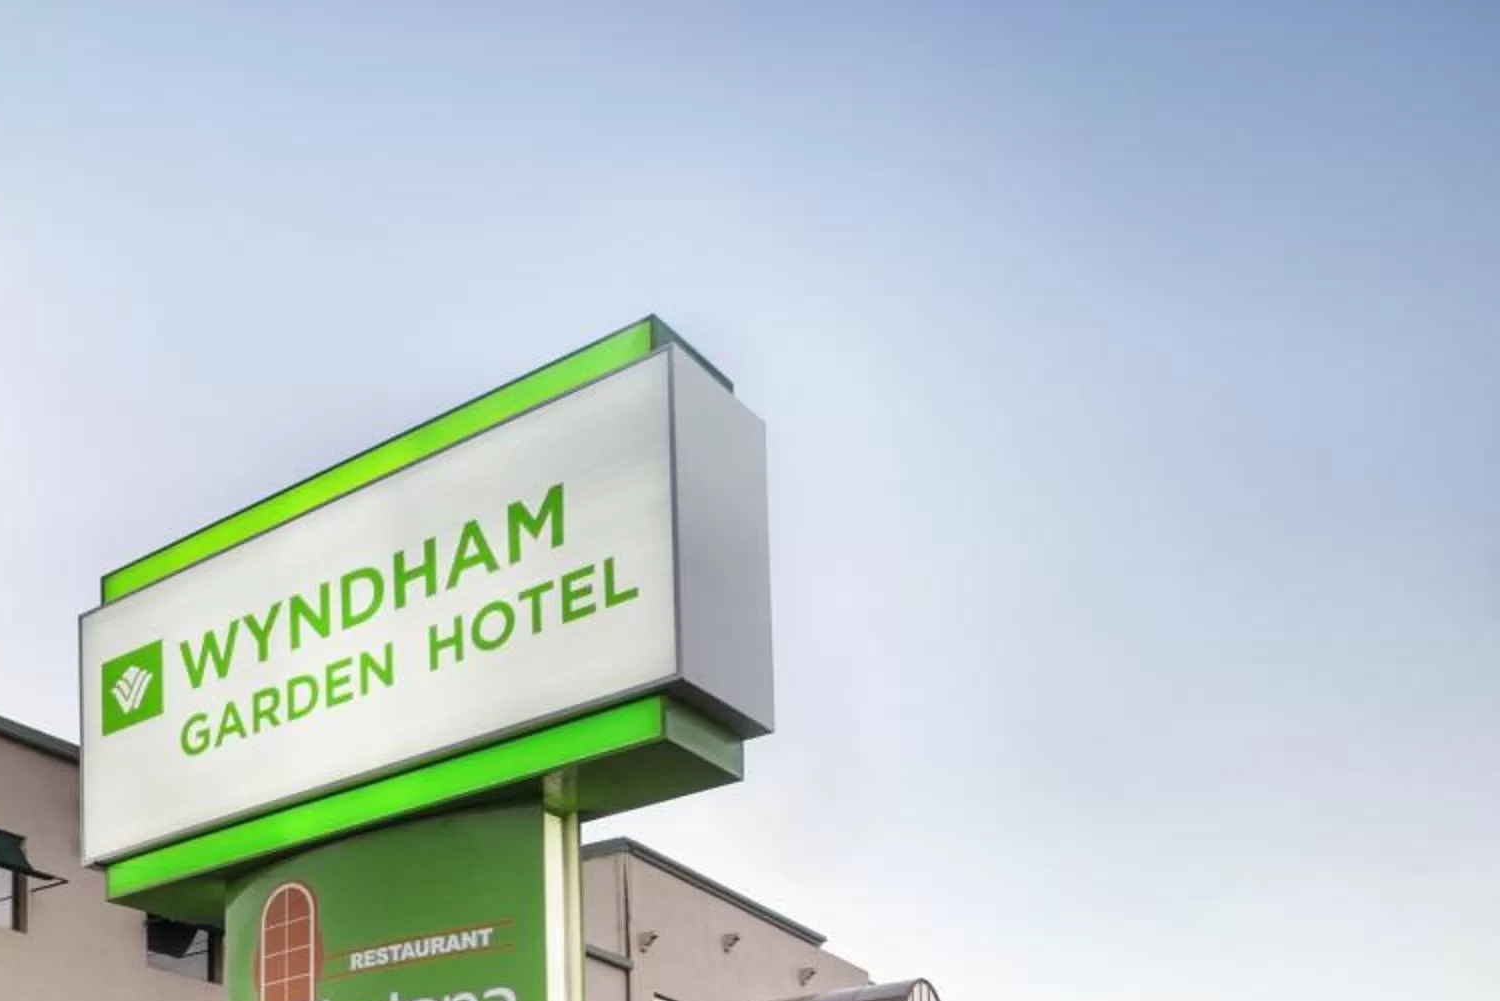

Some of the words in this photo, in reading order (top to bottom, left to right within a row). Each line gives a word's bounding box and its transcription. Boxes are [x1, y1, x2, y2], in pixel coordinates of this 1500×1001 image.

[179, 484, 565, 690] WYNDHAM
[179, 640, 396, 757] GARDEN
[427, 557, 639, 673] HOTEL
[349, 927, 494, 971] RESTAURANT
